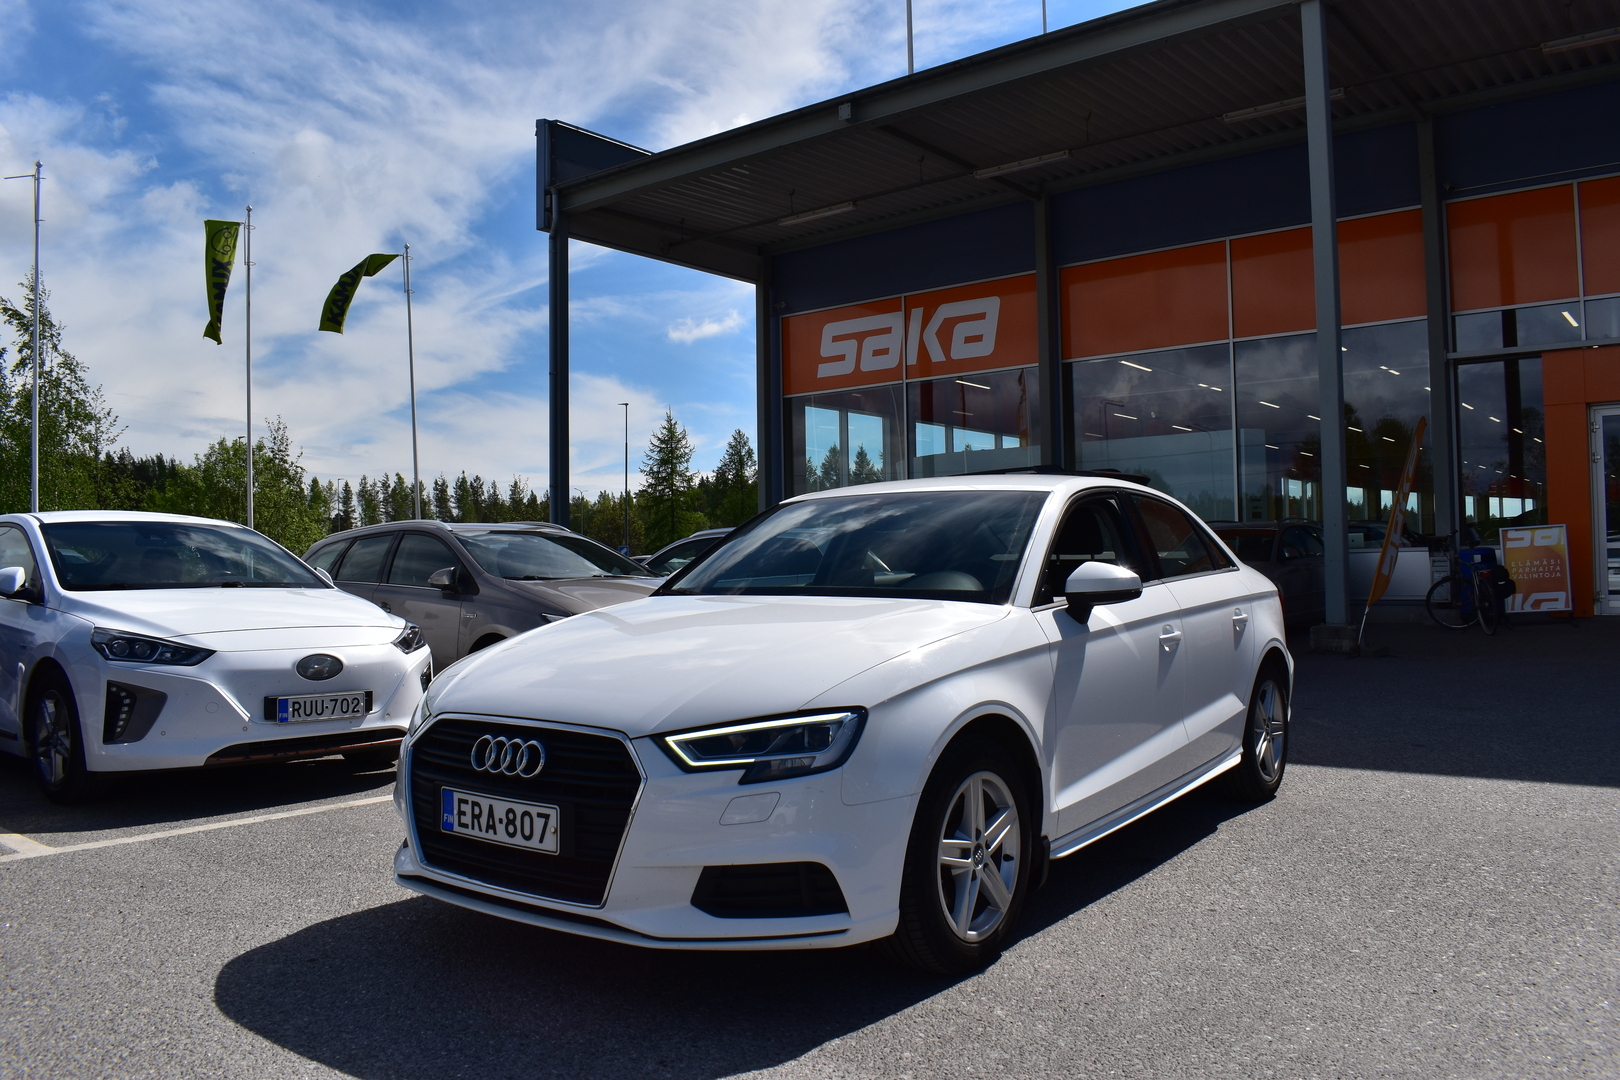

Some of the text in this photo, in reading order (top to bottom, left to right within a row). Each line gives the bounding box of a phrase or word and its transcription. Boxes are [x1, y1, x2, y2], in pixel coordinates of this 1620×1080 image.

[1511, 559, 1561, 567] ELÄMÄSI
[1512, 565, 1561, 573] PARHAITA
[292, 697, 360, 718] RUU-702
[443, 798, 551, 844] FIN ERA-807
